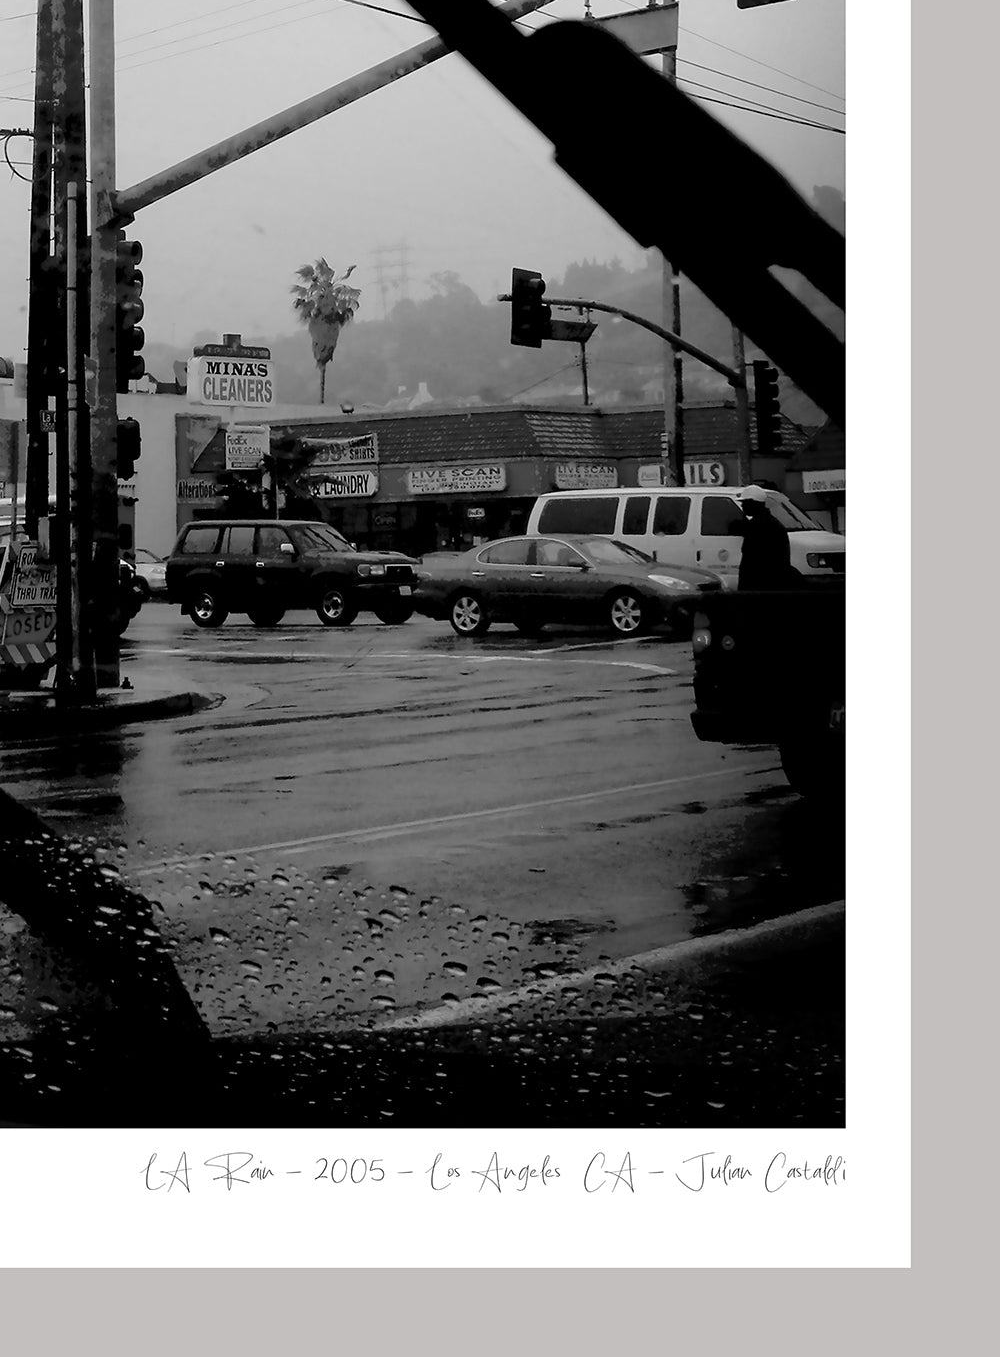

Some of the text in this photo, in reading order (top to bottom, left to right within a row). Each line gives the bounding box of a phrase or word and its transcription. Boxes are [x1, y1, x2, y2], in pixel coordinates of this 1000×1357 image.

[206, 361, 268, 378] MINA'S
[203, 376, 273, 403] CLEANERS
[412, 467, 501, 479] LIVE SCAN
[558, 466, 616, 474] LIVE SCAN
[324, 474, 369, 494] LAUNDRY
[22, 552, 38, 565] ROA
[16, 587, 37, 600] THRU
